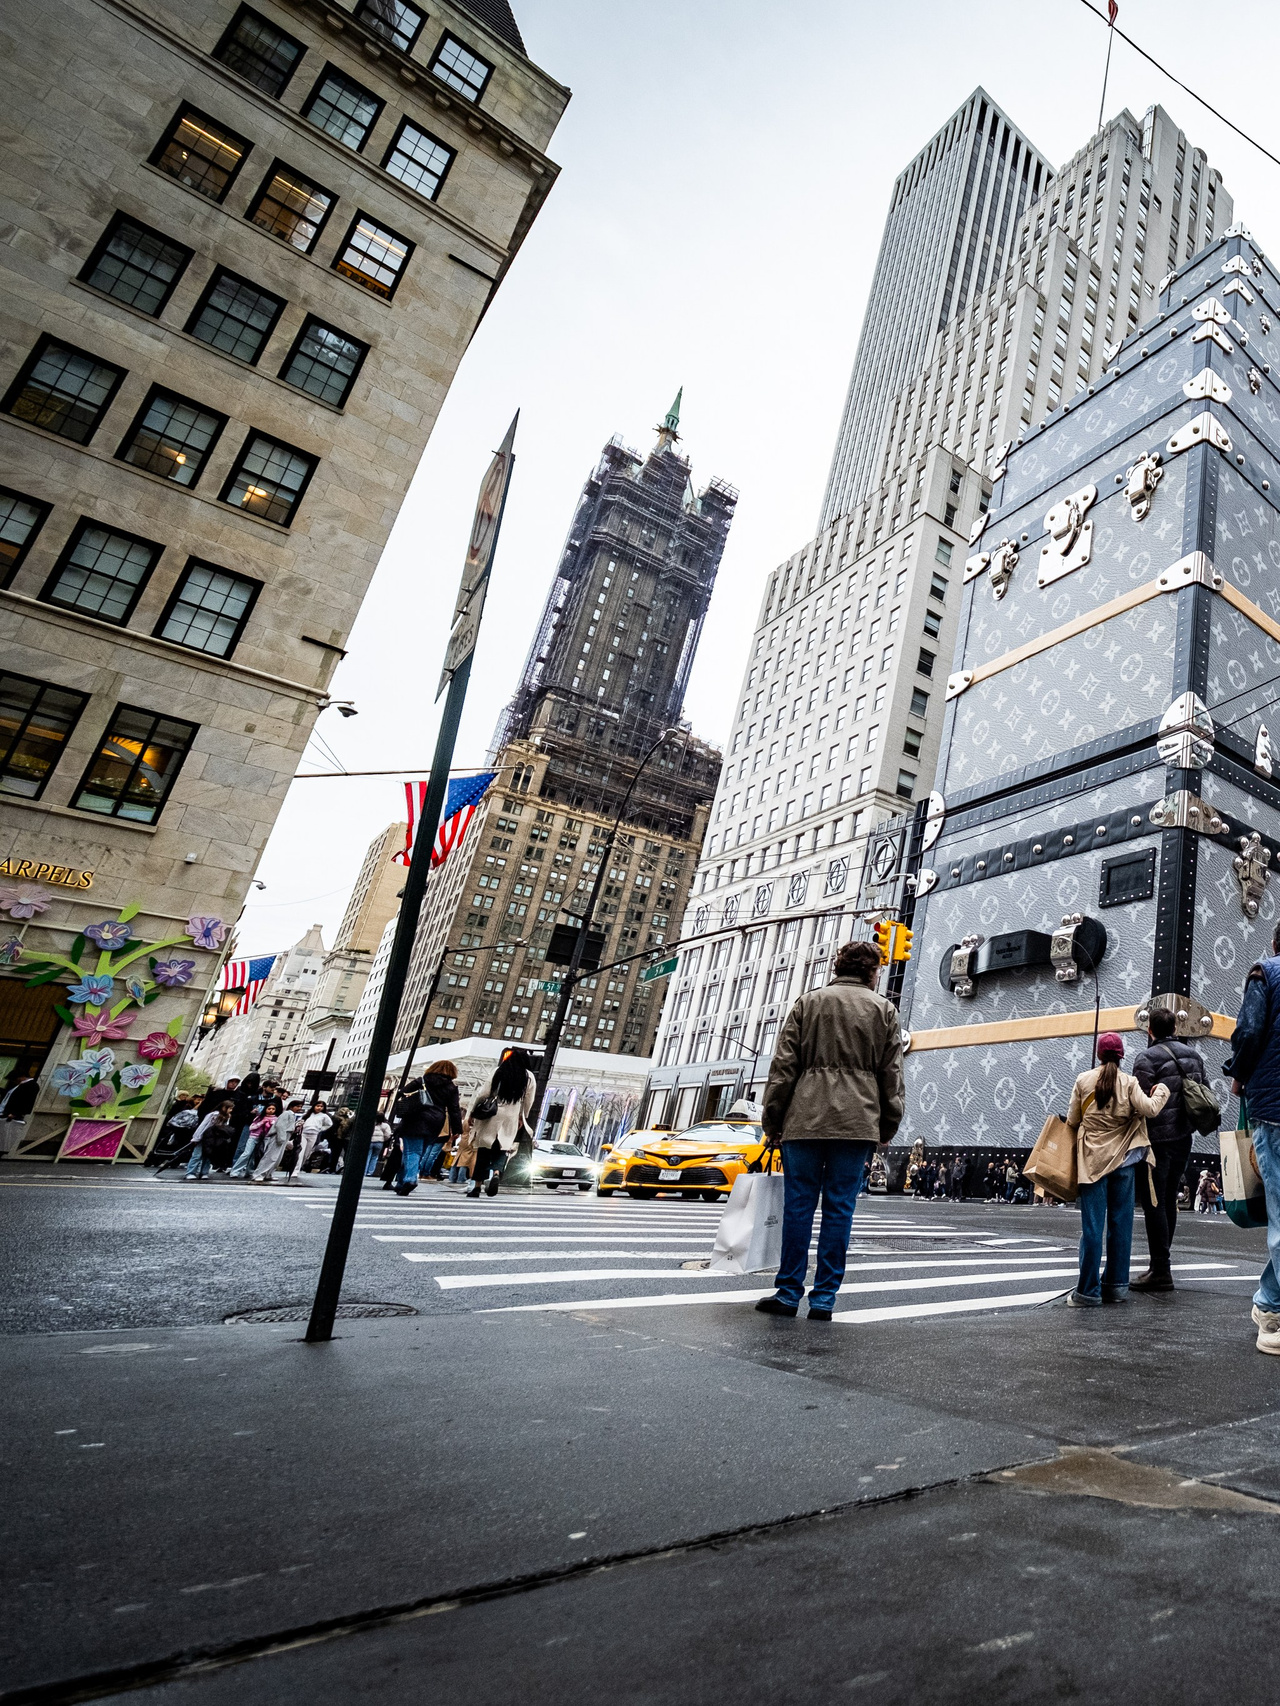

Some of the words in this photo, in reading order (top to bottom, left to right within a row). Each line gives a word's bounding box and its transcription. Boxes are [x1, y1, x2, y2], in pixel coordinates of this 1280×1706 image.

[0, 857, 94, 888] ARPELS
[538, 981, 545, 990] W
[546, 982, 555, 991] 57
